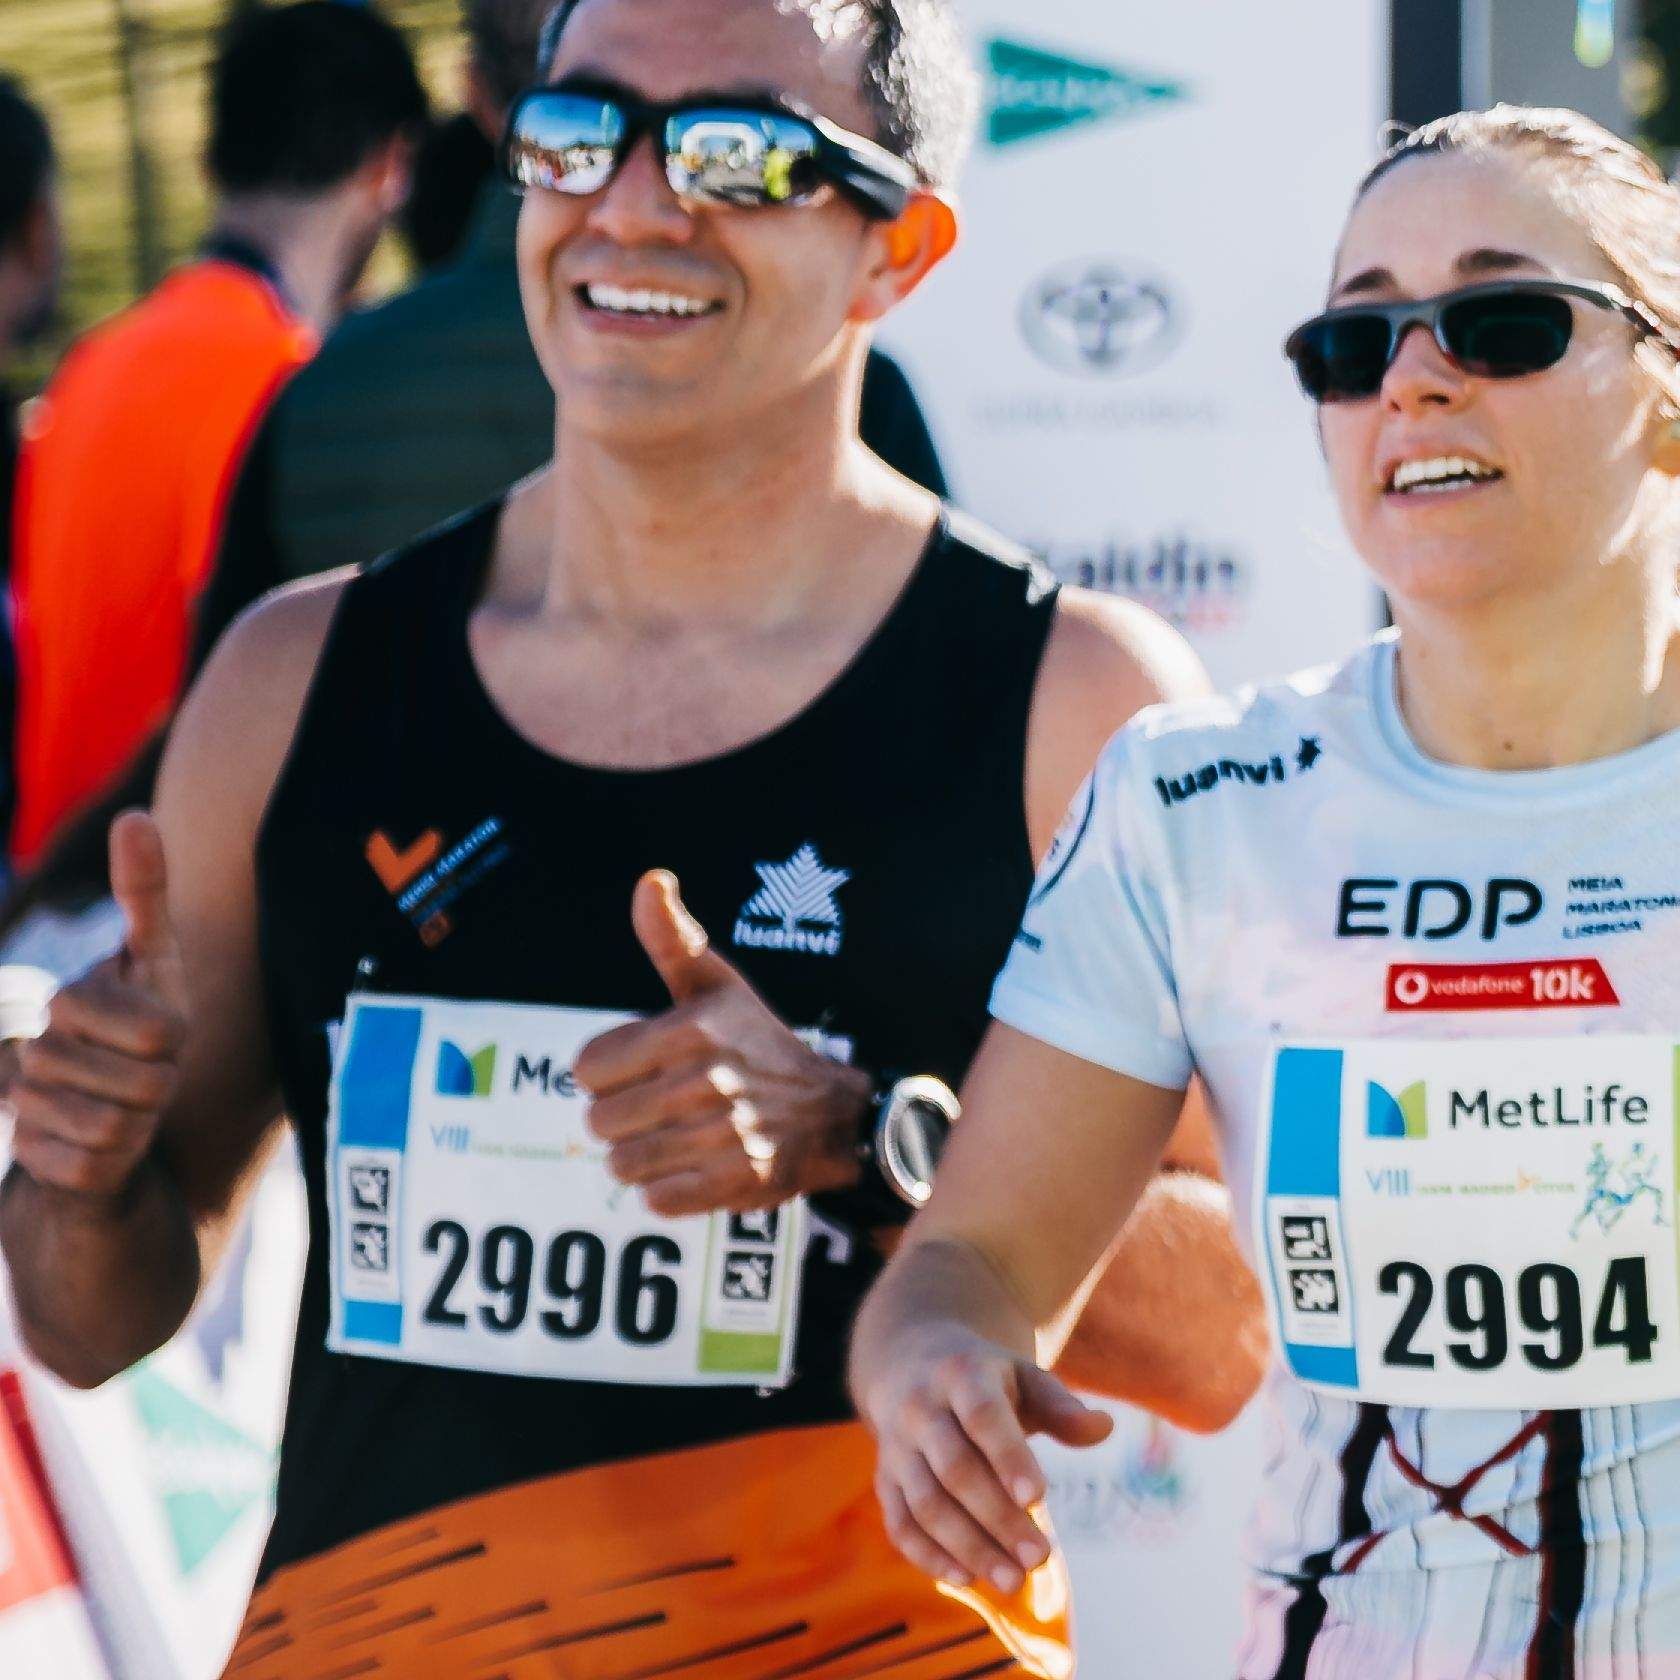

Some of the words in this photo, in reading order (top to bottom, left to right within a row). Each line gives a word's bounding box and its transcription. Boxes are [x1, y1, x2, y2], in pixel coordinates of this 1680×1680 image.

[1336, 878, 1544, 941] EDP
[1430, 973, 1525, 995] vodafone
[1528, 963, 1597, 1002] 10k
[1447, 1080, 1650, 1132] MetLife
[1365, 1168, 1410, 1197] VIII
[420, 1219, 682, 1346] 2996
[1377, 1255, 1659, 1373] 2994
